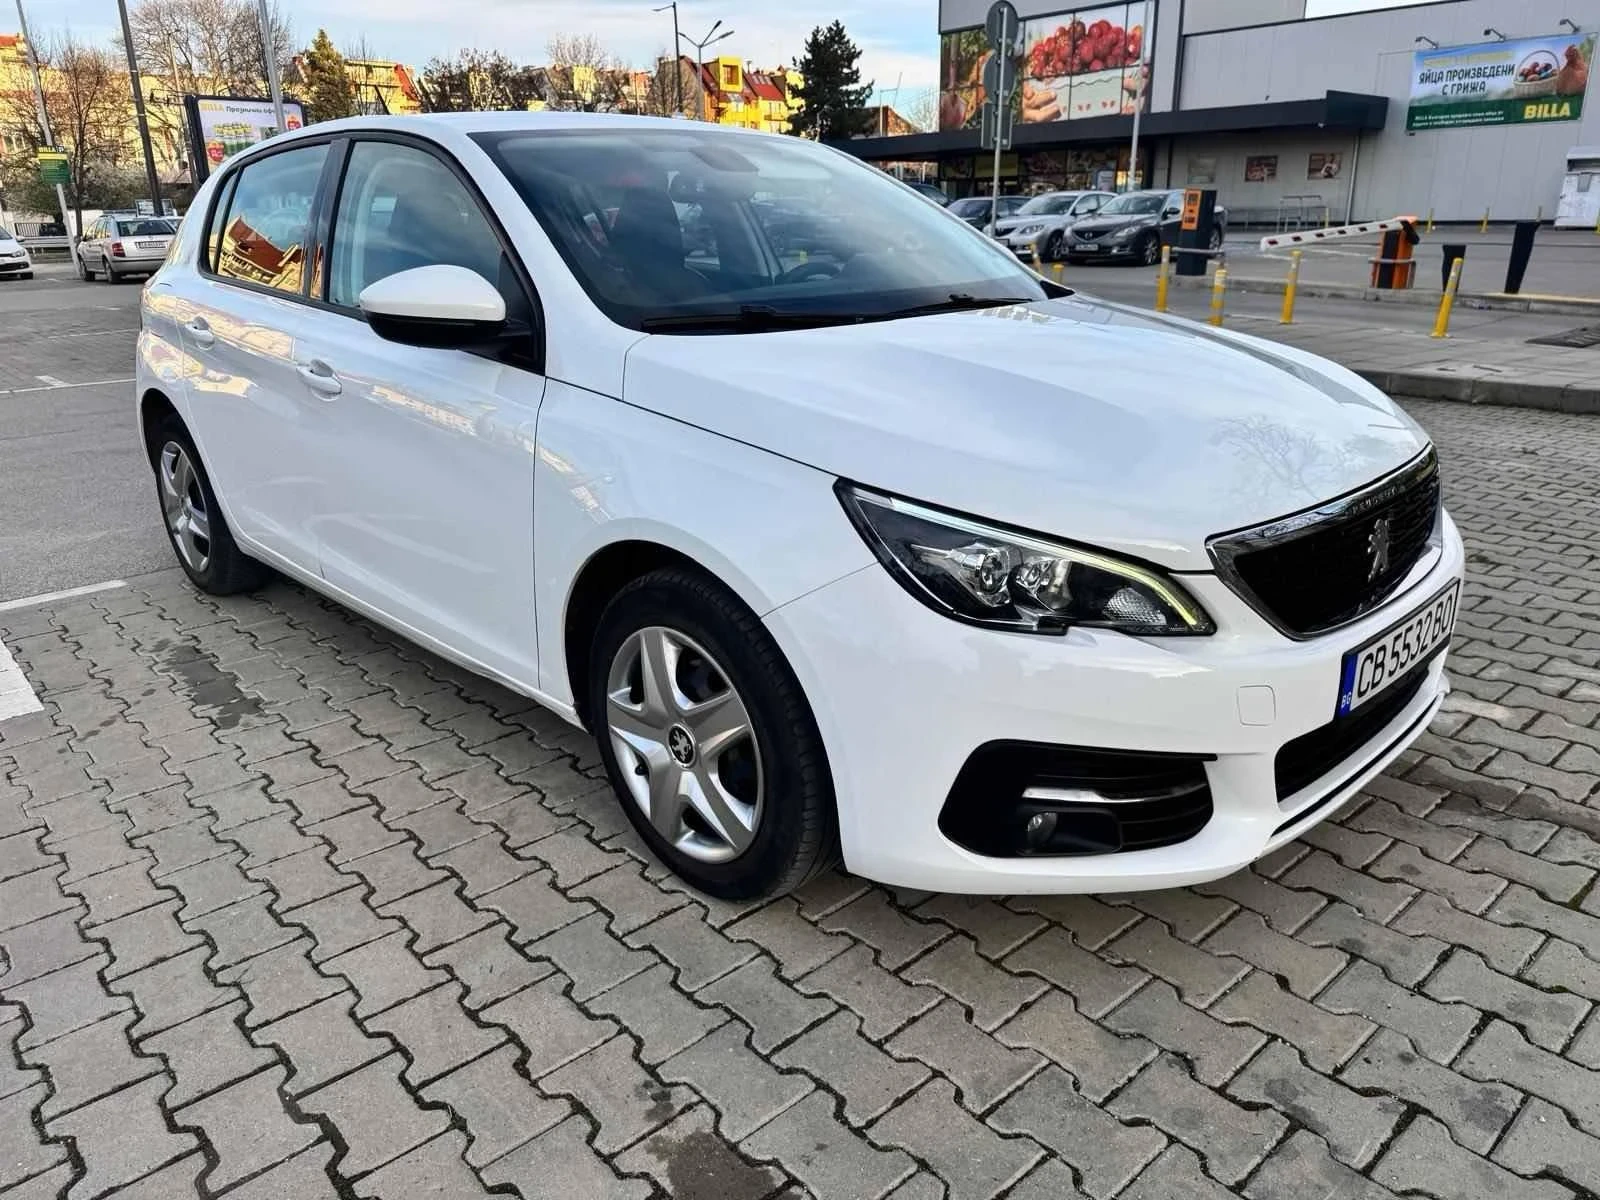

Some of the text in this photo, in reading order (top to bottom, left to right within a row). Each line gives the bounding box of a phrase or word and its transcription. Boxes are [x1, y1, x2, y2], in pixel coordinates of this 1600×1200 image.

[1418, 63, 1516, 85] ЯЙЦА ПРОИЗВЕДЕНИ
[1441, 81, 1486, 95] С ГРИЖА
[1523, 102, 1571, 119] BILLA
[1357, 644, 1387, 698] CB
[1387, 610, 1433, 678] 5532
[1340, 691, 1352, 709] BG
